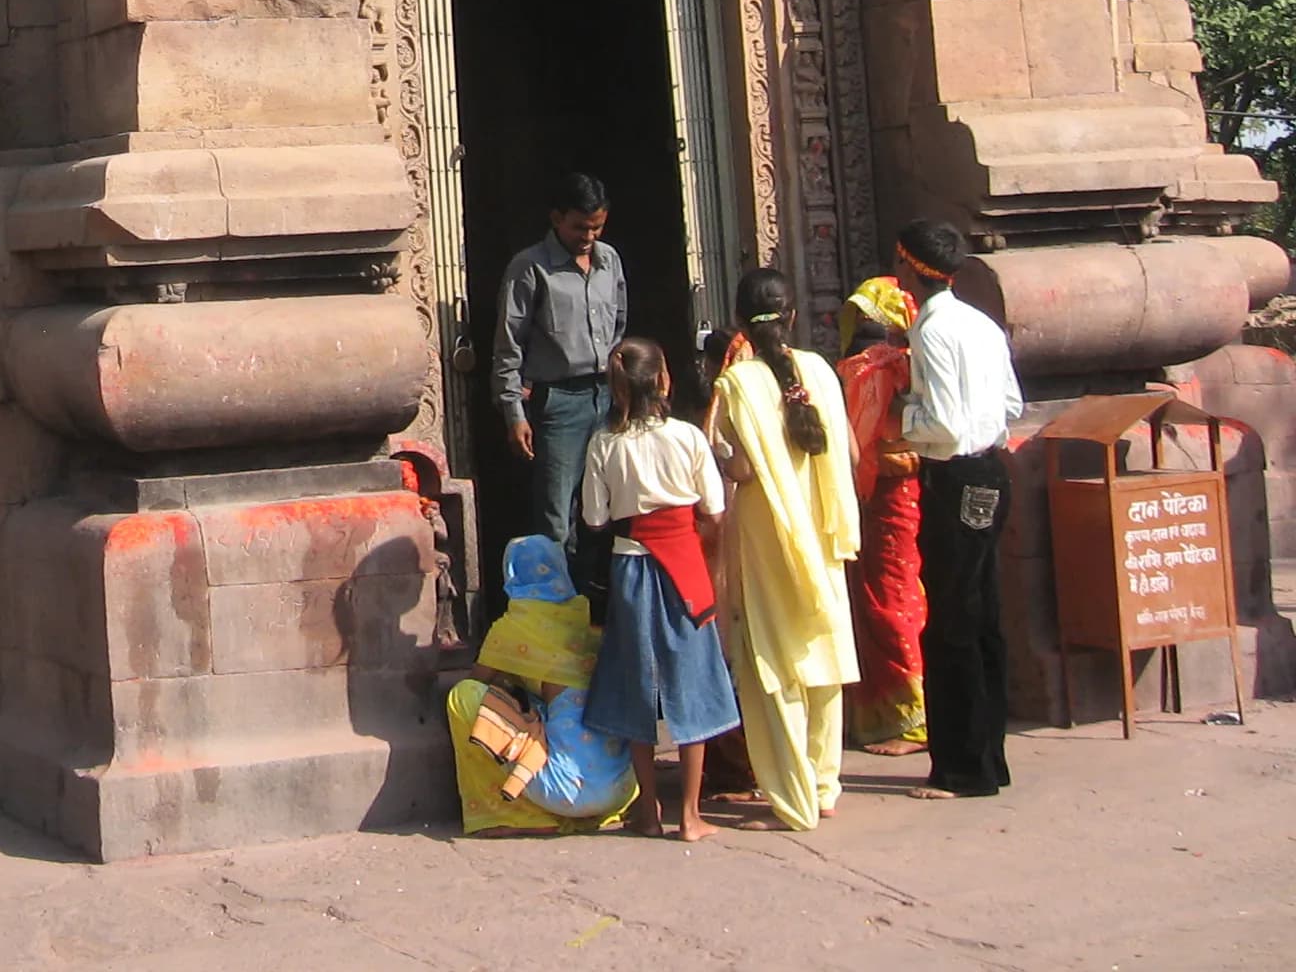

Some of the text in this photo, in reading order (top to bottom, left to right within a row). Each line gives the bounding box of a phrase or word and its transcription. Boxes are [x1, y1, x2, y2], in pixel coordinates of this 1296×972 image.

[1128, 491, 1207, 523] दान पेटिका
[1179, 543, 1216, 563] पेटिका
